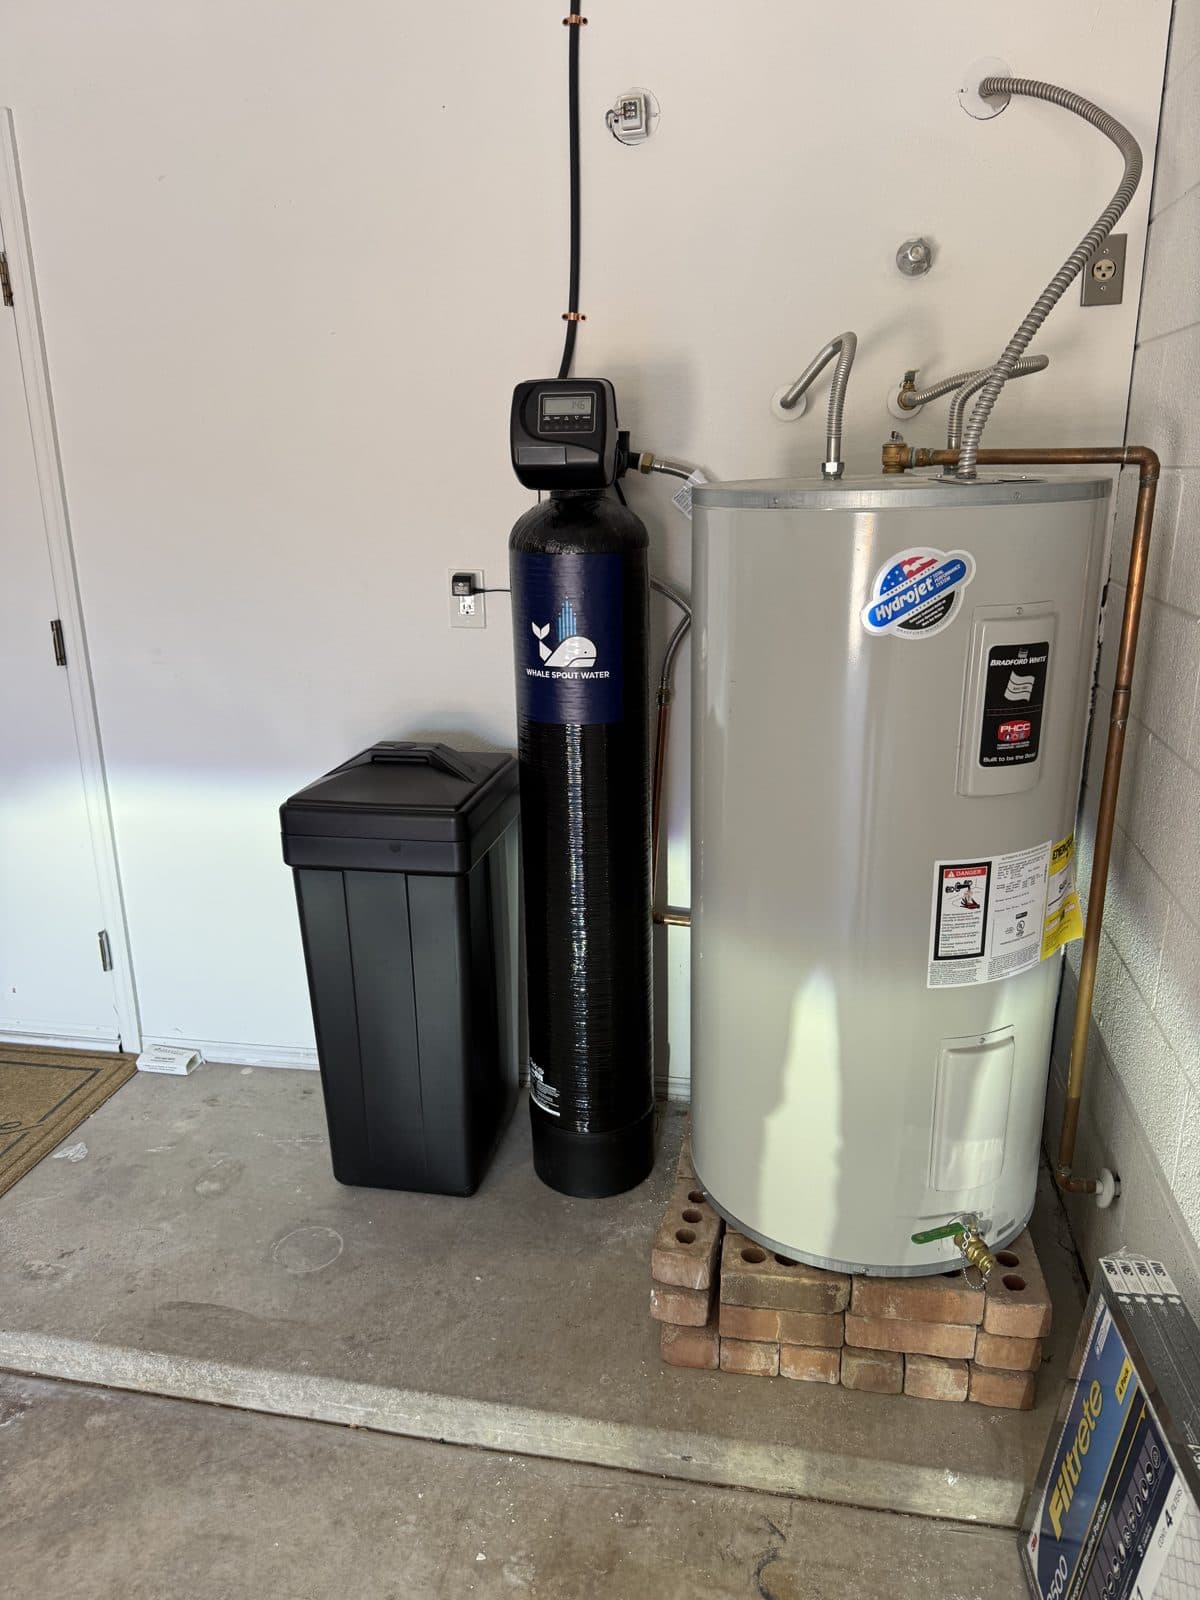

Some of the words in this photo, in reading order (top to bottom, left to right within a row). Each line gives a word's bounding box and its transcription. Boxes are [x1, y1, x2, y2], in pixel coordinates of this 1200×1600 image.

[874, 575, 935, 622] Hydrojet
[990, 658, 1029, 667] BRADFORD
[526, 667, 550, 679] WHALE
[551, 671, 578, 680] SPOUT
[580, 670, 610, 680] WATER
[1000, 723, 1031, 733] PHCC
[956, 868, 983, 877] DANGER
[1048, 1379, 1103, 1542] Filtrete
